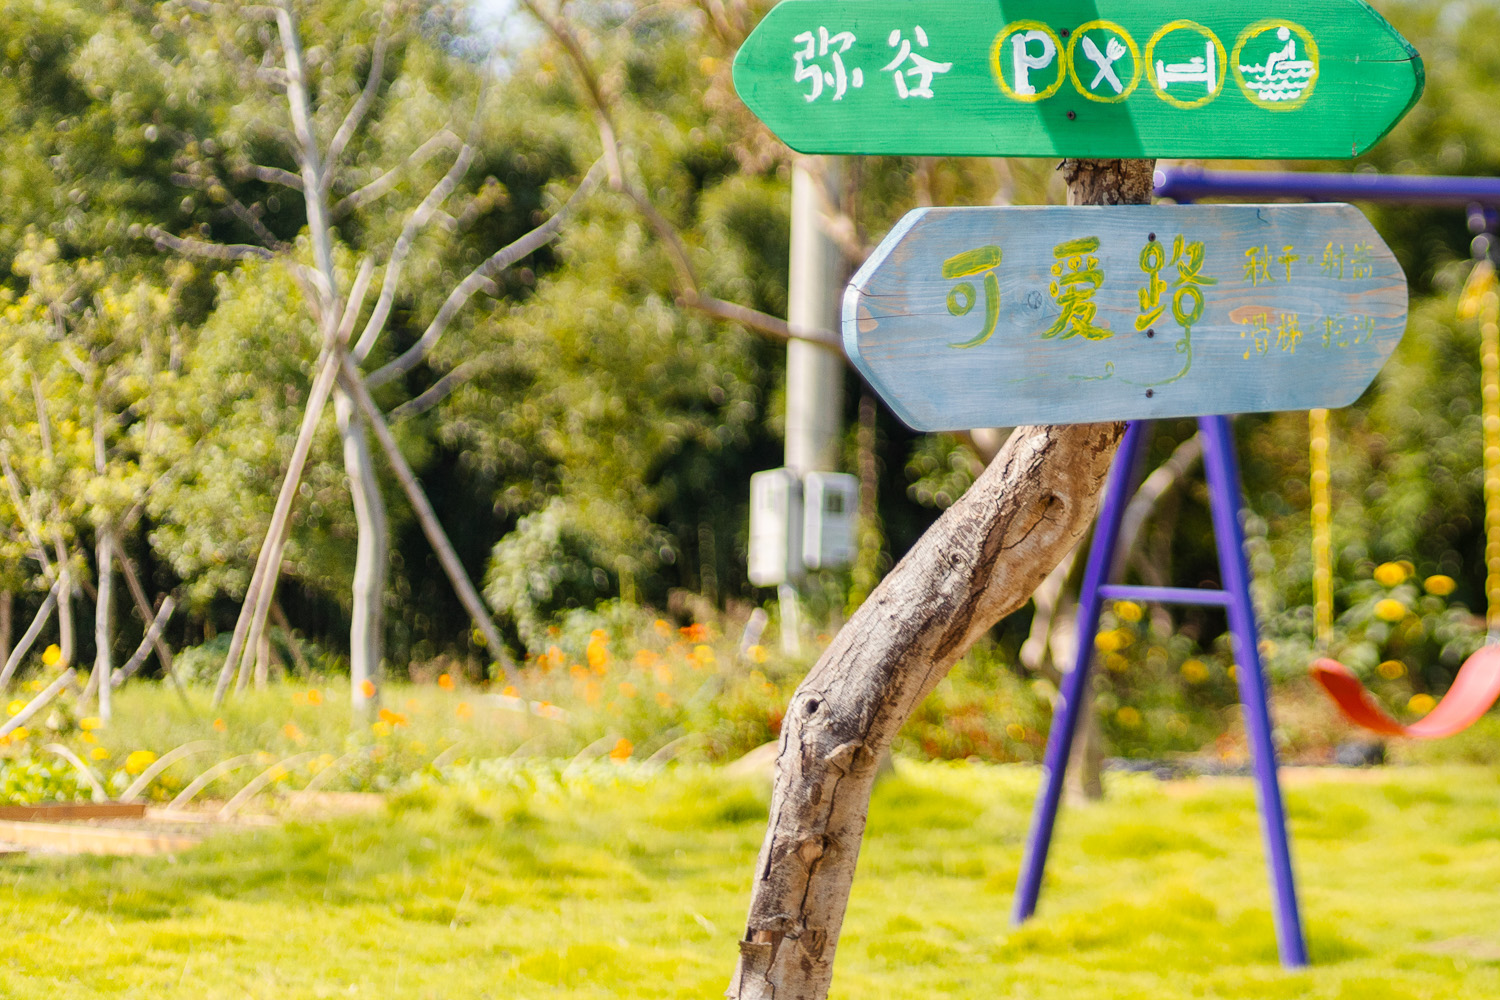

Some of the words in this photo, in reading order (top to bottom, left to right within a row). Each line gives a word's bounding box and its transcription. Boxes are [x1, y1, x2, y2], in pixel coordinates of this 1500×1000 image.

[794, 25, 953, 102] 弥谷
[941, 235, 1219, 349] 可爱路
